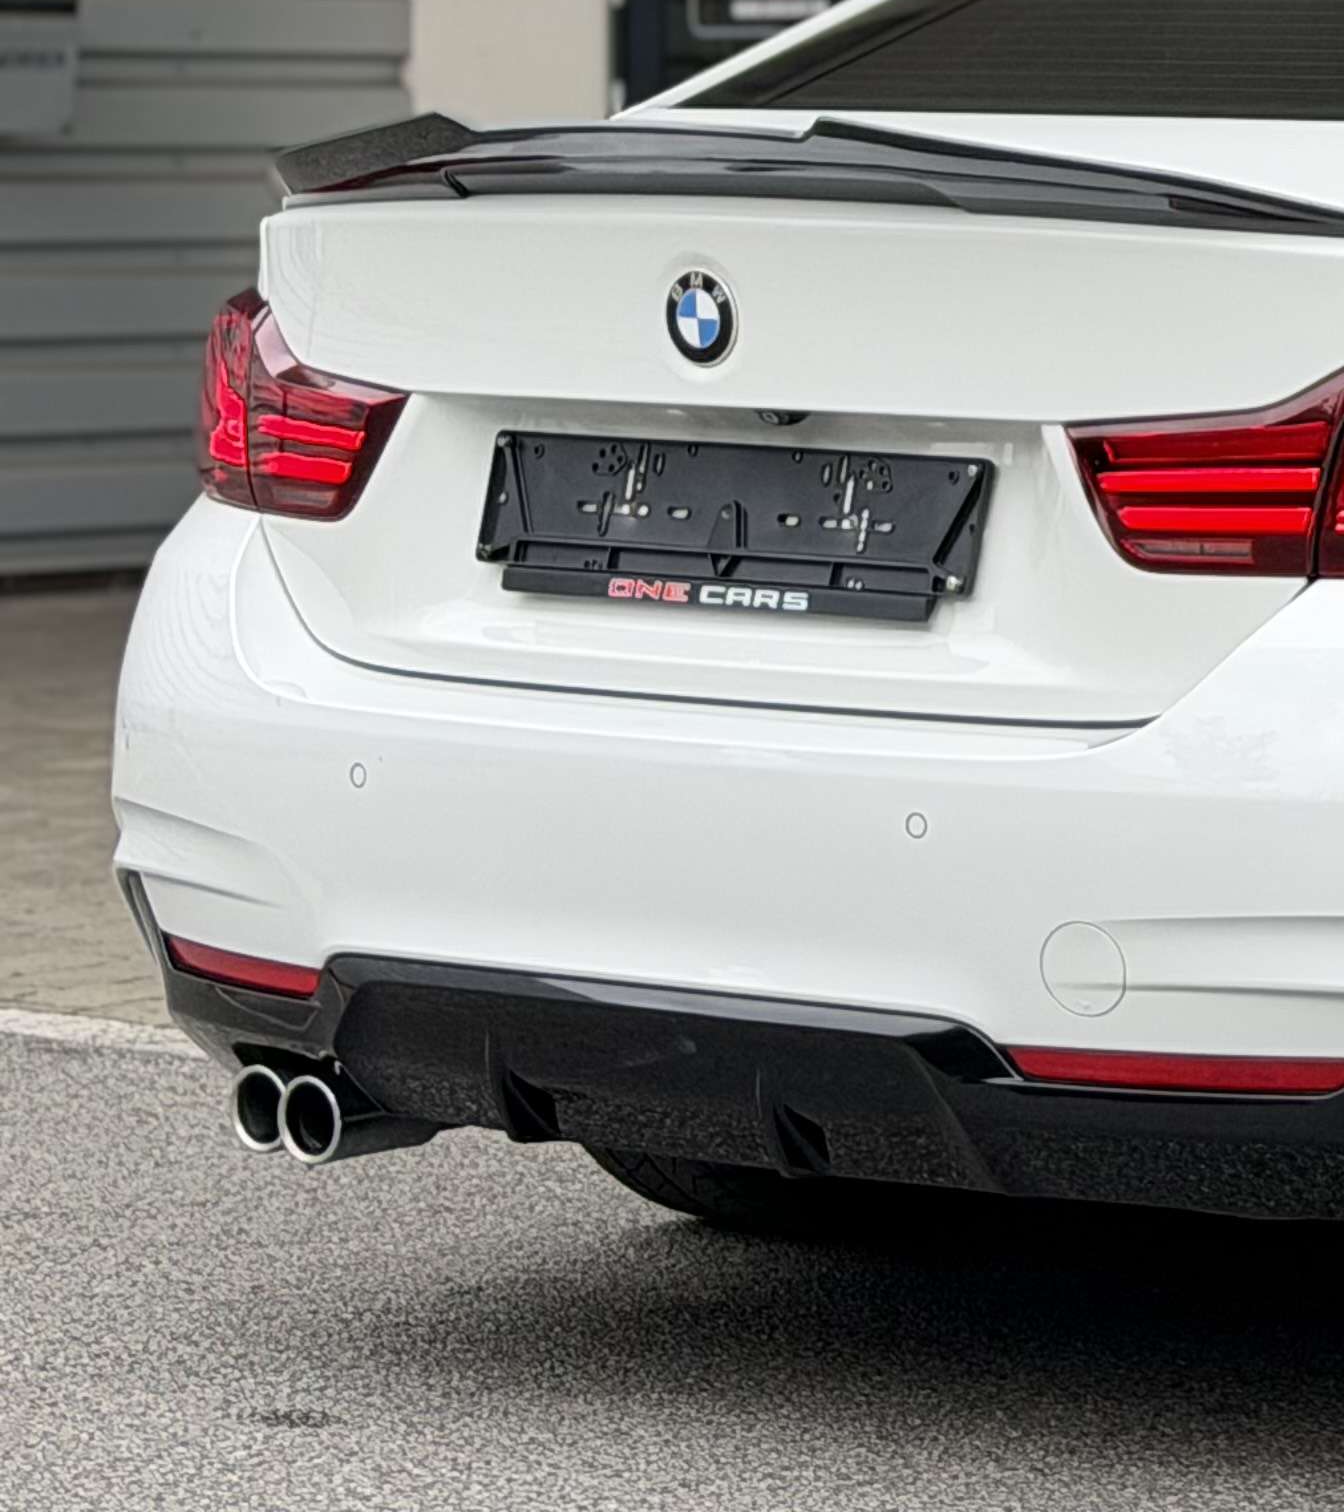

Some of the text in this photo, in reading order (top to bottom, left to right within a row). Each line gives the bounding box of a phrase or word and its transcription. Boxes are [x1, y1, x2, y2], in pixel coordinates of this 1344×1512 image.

[670, 271, 726, 304] BMW
[608, 576, 809, 612] ONE CARS
